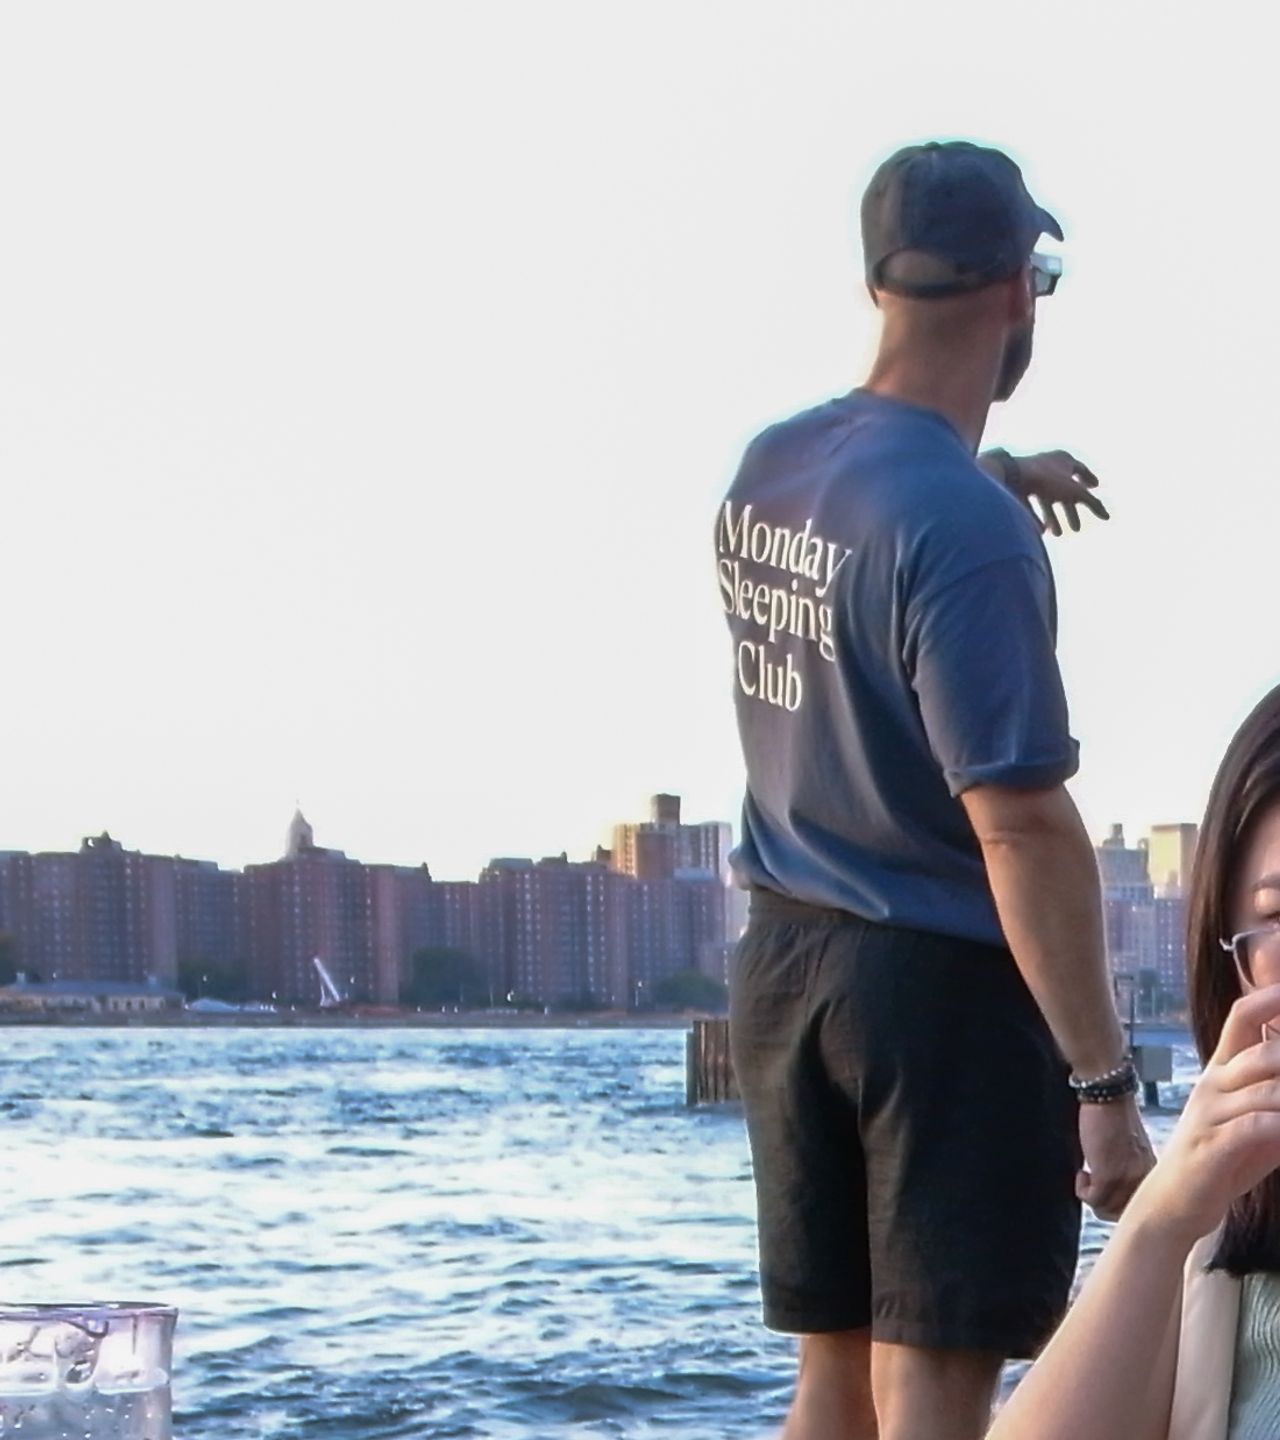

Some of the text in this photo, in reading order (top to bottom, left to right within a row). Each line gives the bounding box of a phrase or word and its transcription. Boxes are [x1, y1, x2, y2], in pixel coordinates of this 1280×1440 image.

[718, 500, 853, 597] Monday
[717, 558, 837, 662] Sleeping
[738, 640, 803, 711] Club
